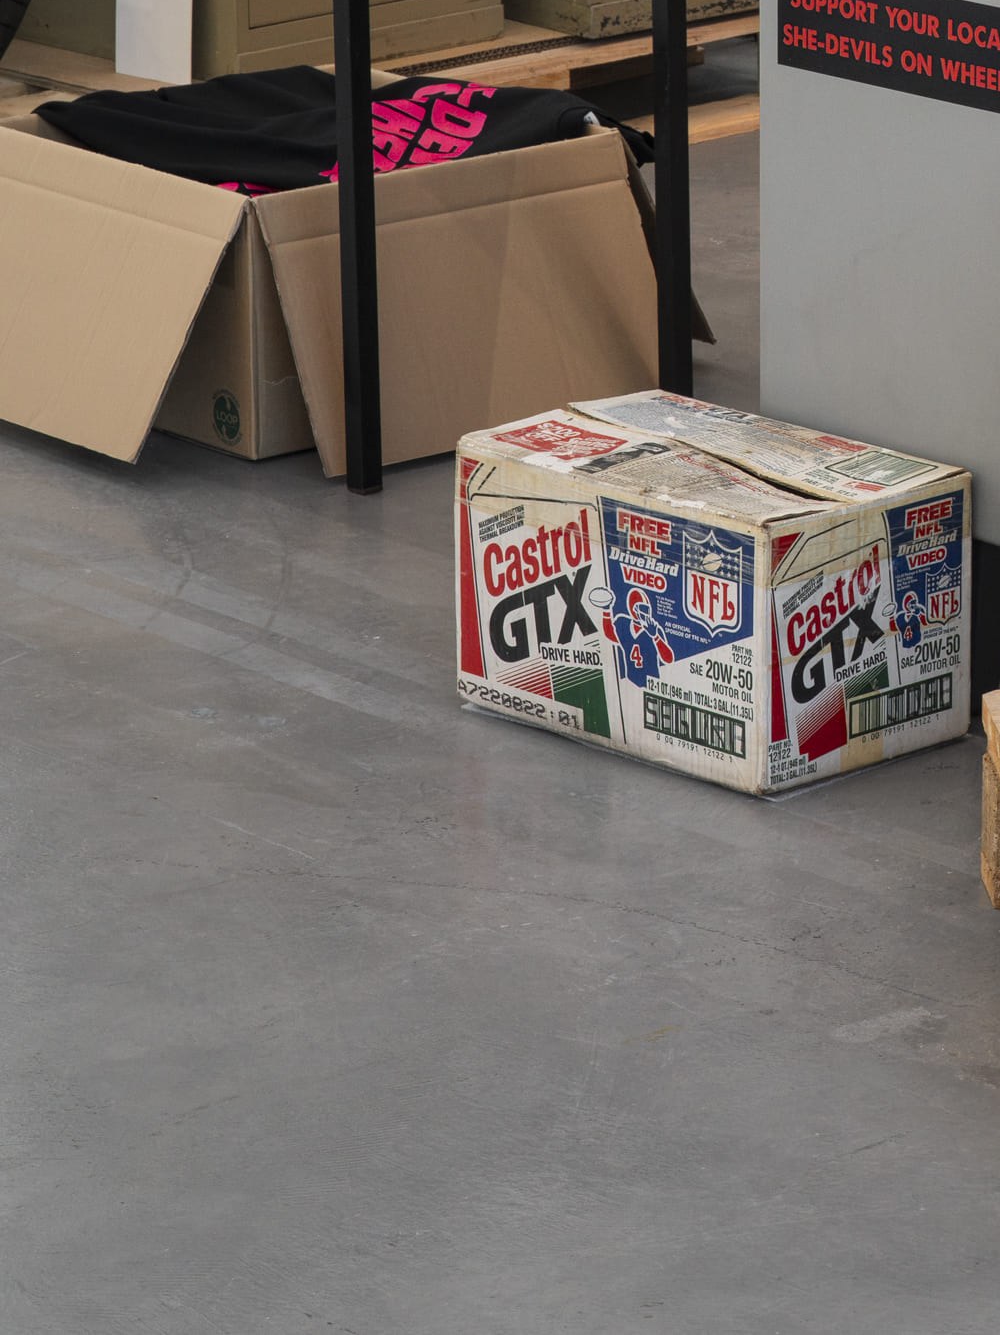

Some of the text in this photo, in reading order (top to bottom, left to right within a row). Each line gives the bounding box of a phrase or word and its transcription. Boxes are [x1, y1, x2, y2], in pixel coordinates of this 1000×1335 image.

[885, 6, 941, 39] YOUR
[783, 23, 893, 68] SHE-DEVILS
[900, 50, 934, 77] ON
[617, 509, 672, 542] FREE
[906, 500, 953, 527] FREE
[915, 523, 942, 538] NFL
[483, 508, 592, 597] Castrol
[629, 534, 662, 556] NFL
[908, 549, 946, 568] VIDEO
[622, 566, 666, 591] VIDEO
[691, 573, 735, 623] NFL
[787, 544, 881, 656] Castrol
[930, 590, 959, 619] NFL
[489, 563, 598, 663] GTX
[541, 645, 570, 663] DRIVE
[630, 645, 643, 668] 4
[731, 644, 744, 654] PART
[791, 585, 884, 704] GTX
[901, 634, 961, 669] SAE 20W-50
[732, 653, 752, 667] 12122
[920, 655, 961, 675] MOTOR OIL
[690, 659, 753, 691] SAE 20W-50
[836, 663, 861, 683] DRIVE
[712, 682, 754, 704] MOTOR OIL
[768, 742, 783, 752] PART
[768, 748, 792, 763] 12122
